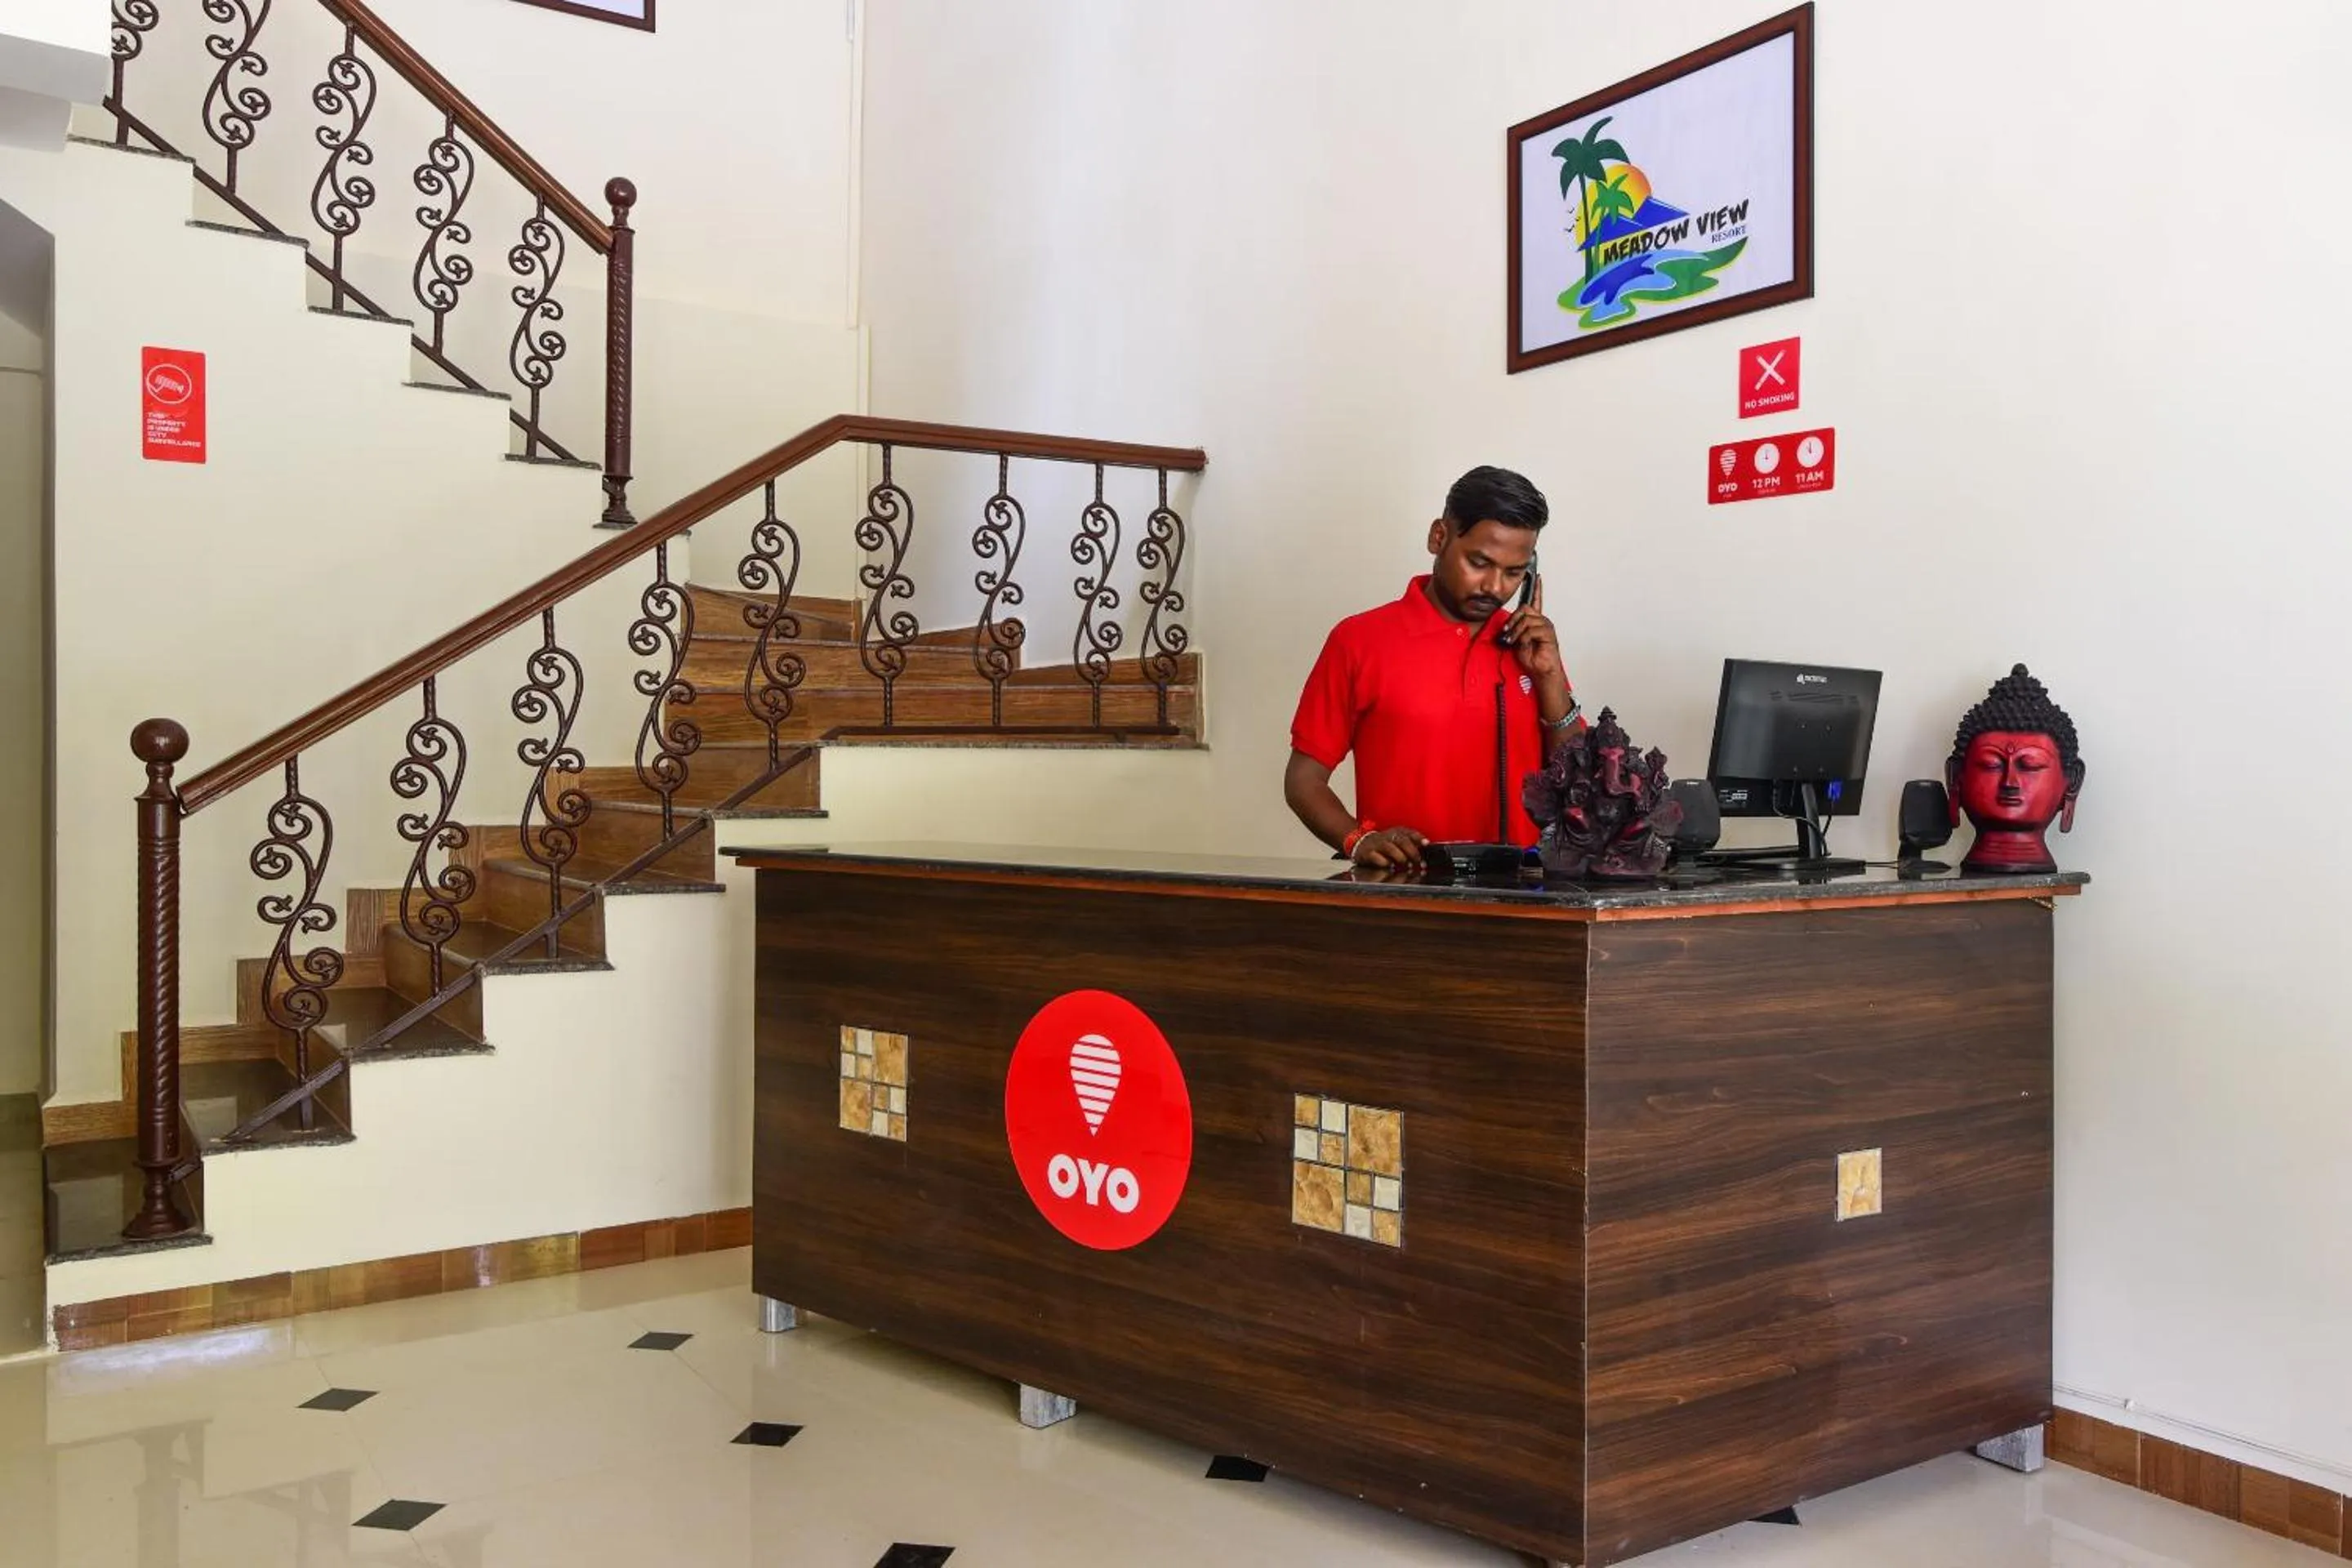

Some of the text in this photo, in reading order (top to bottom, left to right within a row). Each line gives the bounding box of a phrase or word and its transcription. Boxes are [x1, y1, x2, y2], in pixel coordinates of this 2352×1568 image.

[1603, 198, 1749, 266] MEADOW VIEW
[1711, 225, 1746, 243] RESORT
[1744, 392, 1795, 410] NO SMOKING
[1752, 476, 1780, 489] 12 PM
[1795, 470, 1824, 483] 11 AM
[1717, 483, 1738, 494] OYO
[1048, 1153, 1139, 1213] OYO
